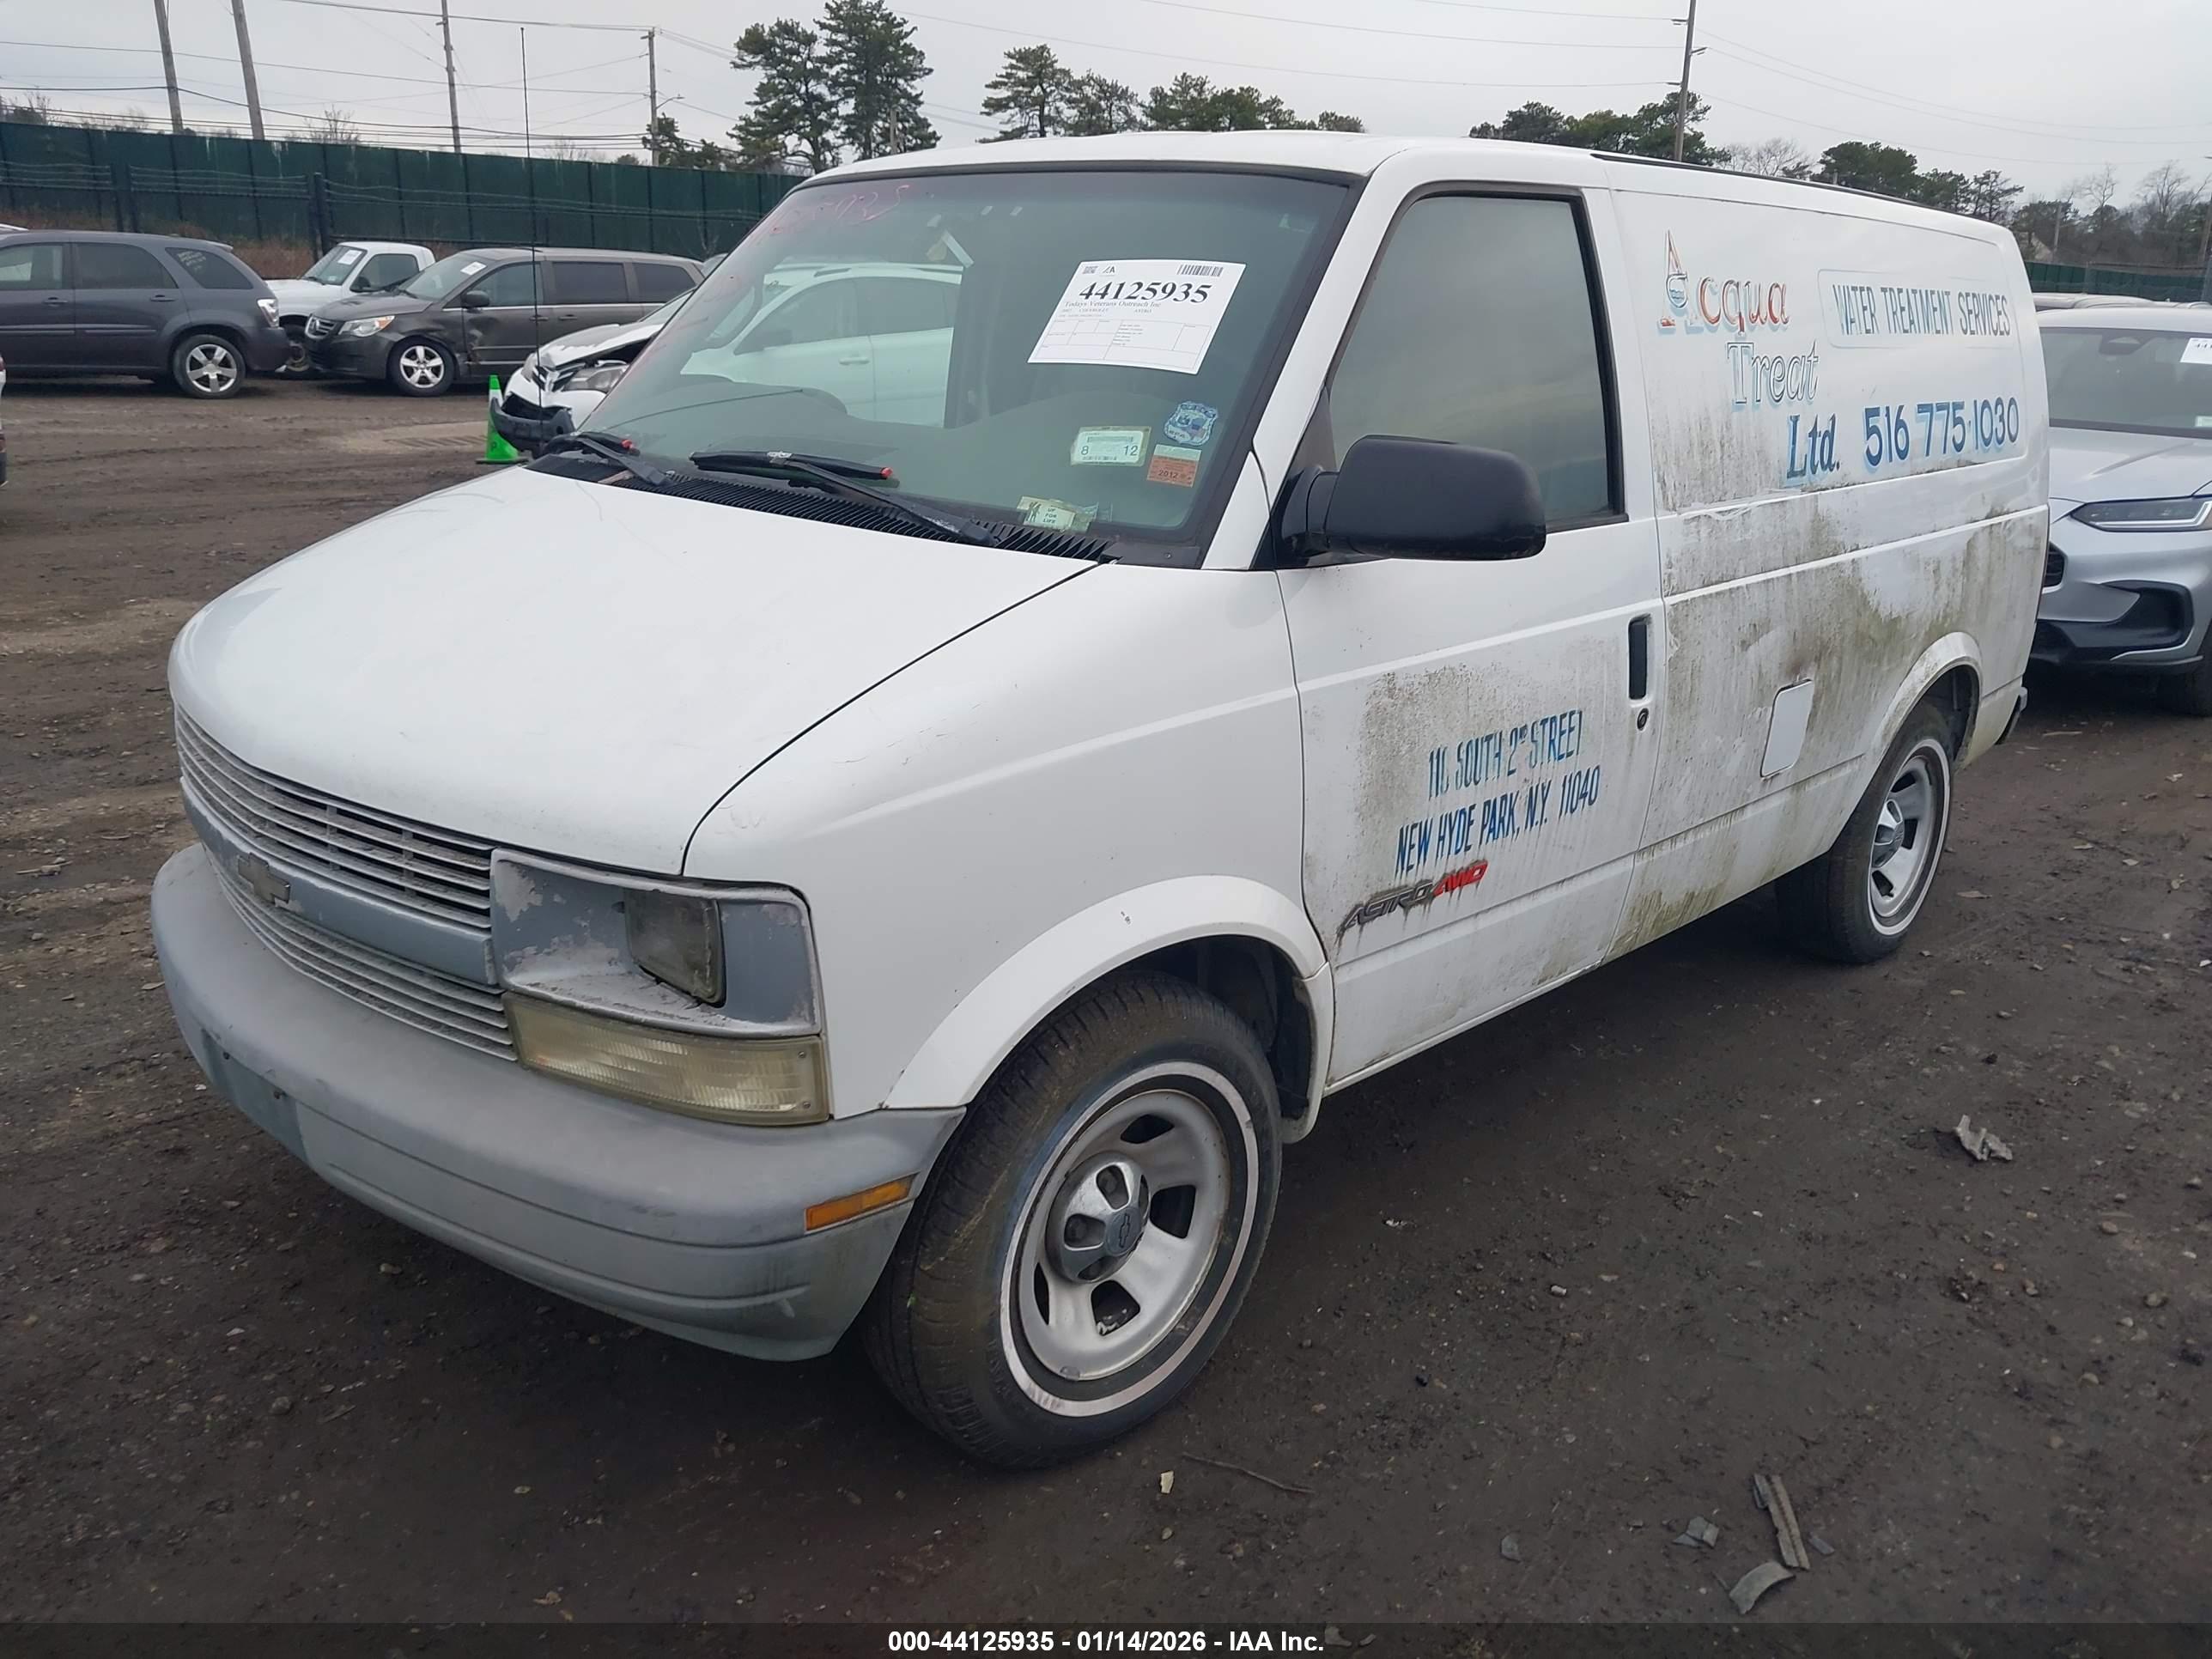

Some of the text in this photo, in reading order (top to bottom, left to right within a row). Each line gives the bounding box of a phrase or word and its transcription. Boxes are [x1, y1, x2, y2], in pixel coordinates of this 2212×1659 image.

[1079, 281, 1212, 303] 44125935
[1832, 284, 2011, 337] WATER TREATMENT SERVICES
[1727, 339, 1820, 405] Treat
[1080, 445, 1139, 456] 8 12
[1786, 413, 1841, 480] Ltd.
[1864, 405, 1911, 467] 516
[1158, 469, 1179, 479] 2012
[1455, 731, 1503, 790] SOUTH
[1529, 709, 1583, 769] STREET
[1395, 817, 1433, 875] NEW
[1436, 804, 1476, 859] HYDE
[1479, 790, 1521, 846] PARK,
[1558, 764, 1601, 820] 11040
